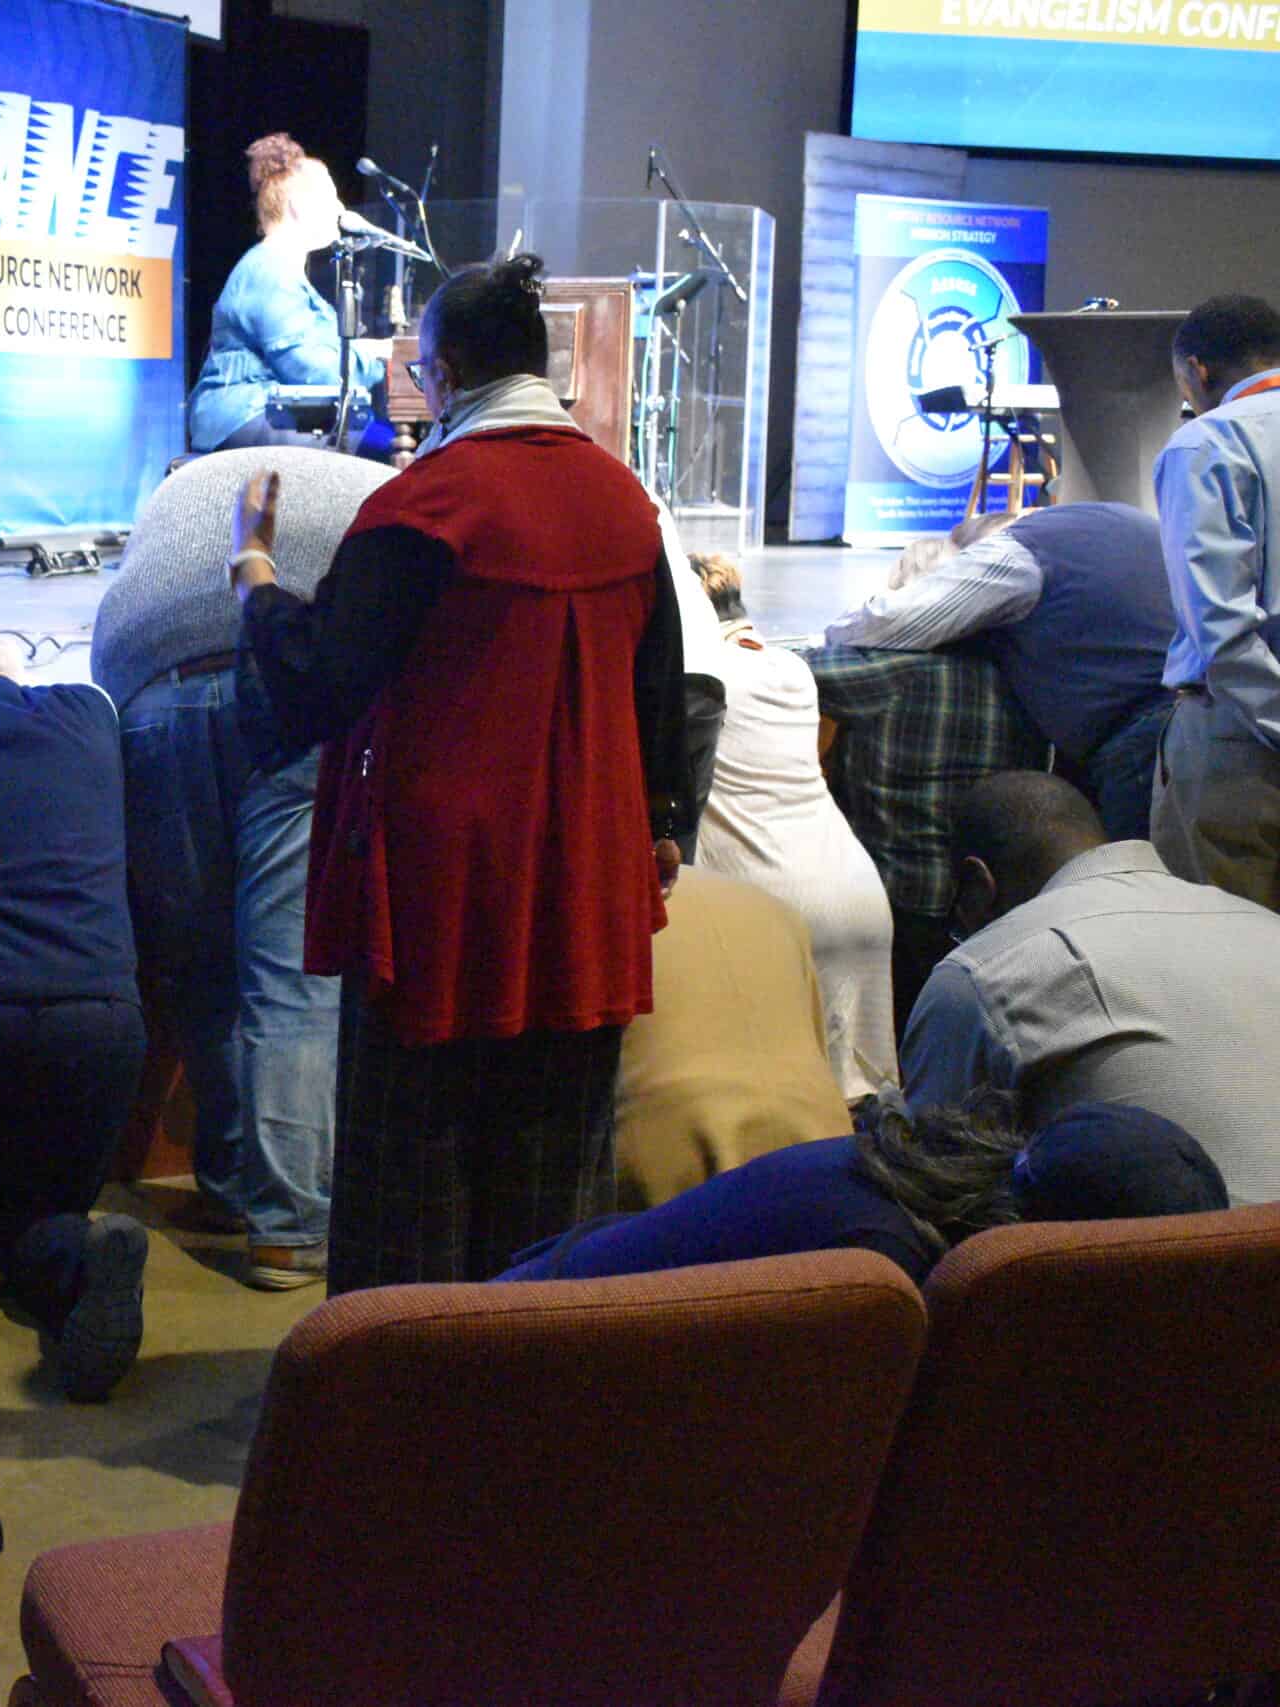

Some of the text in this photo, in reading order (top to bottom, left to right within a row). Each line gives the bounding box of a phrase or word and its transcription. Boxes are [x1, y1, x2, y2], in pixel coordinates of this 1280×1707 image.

[939, 0, 1280, 42] EVANGELISM CONF
[48, 260, 144, 299] NETWORK
[2, 305, 128, 343] CONFERENCE
